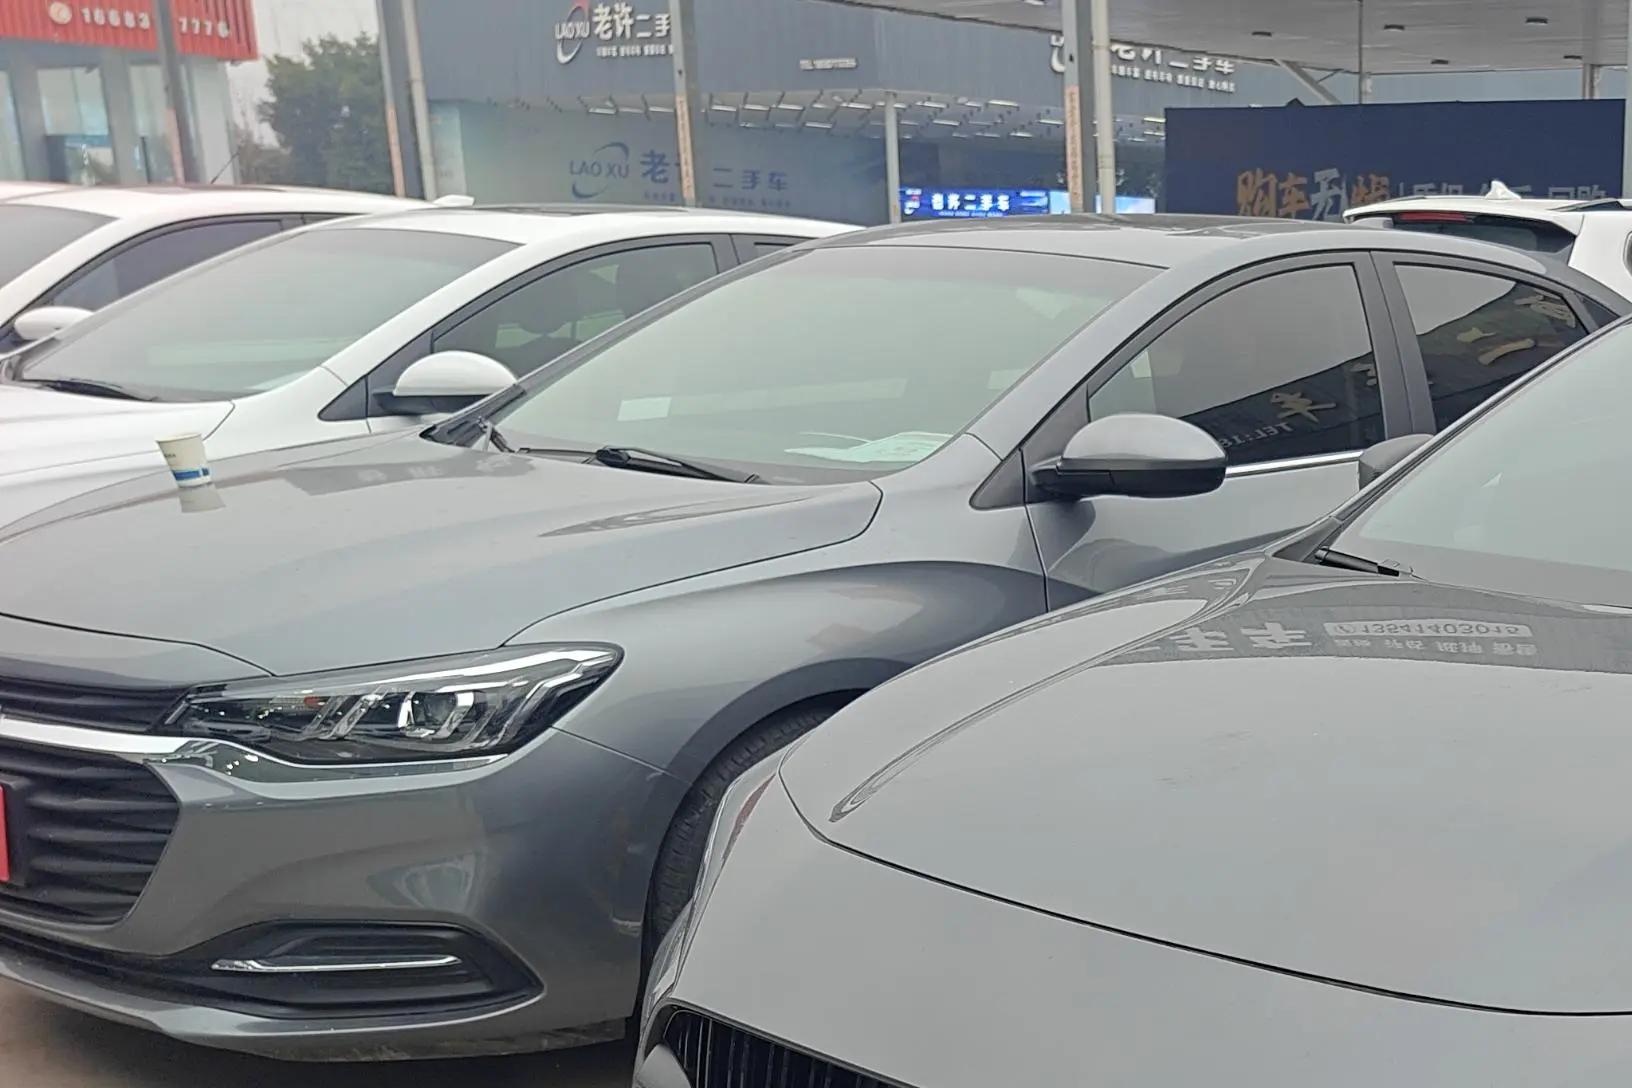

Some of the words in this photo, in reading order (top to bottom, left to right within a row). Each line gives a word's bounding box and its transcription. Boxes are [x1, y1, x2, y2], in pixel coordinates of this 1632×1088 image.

[592, 2, 672, 40] 老许二手
[570, 159, 602, 177] LAO
[605, 162, 630, 179] XU
[640, 149, 789, 192] 老二手车
